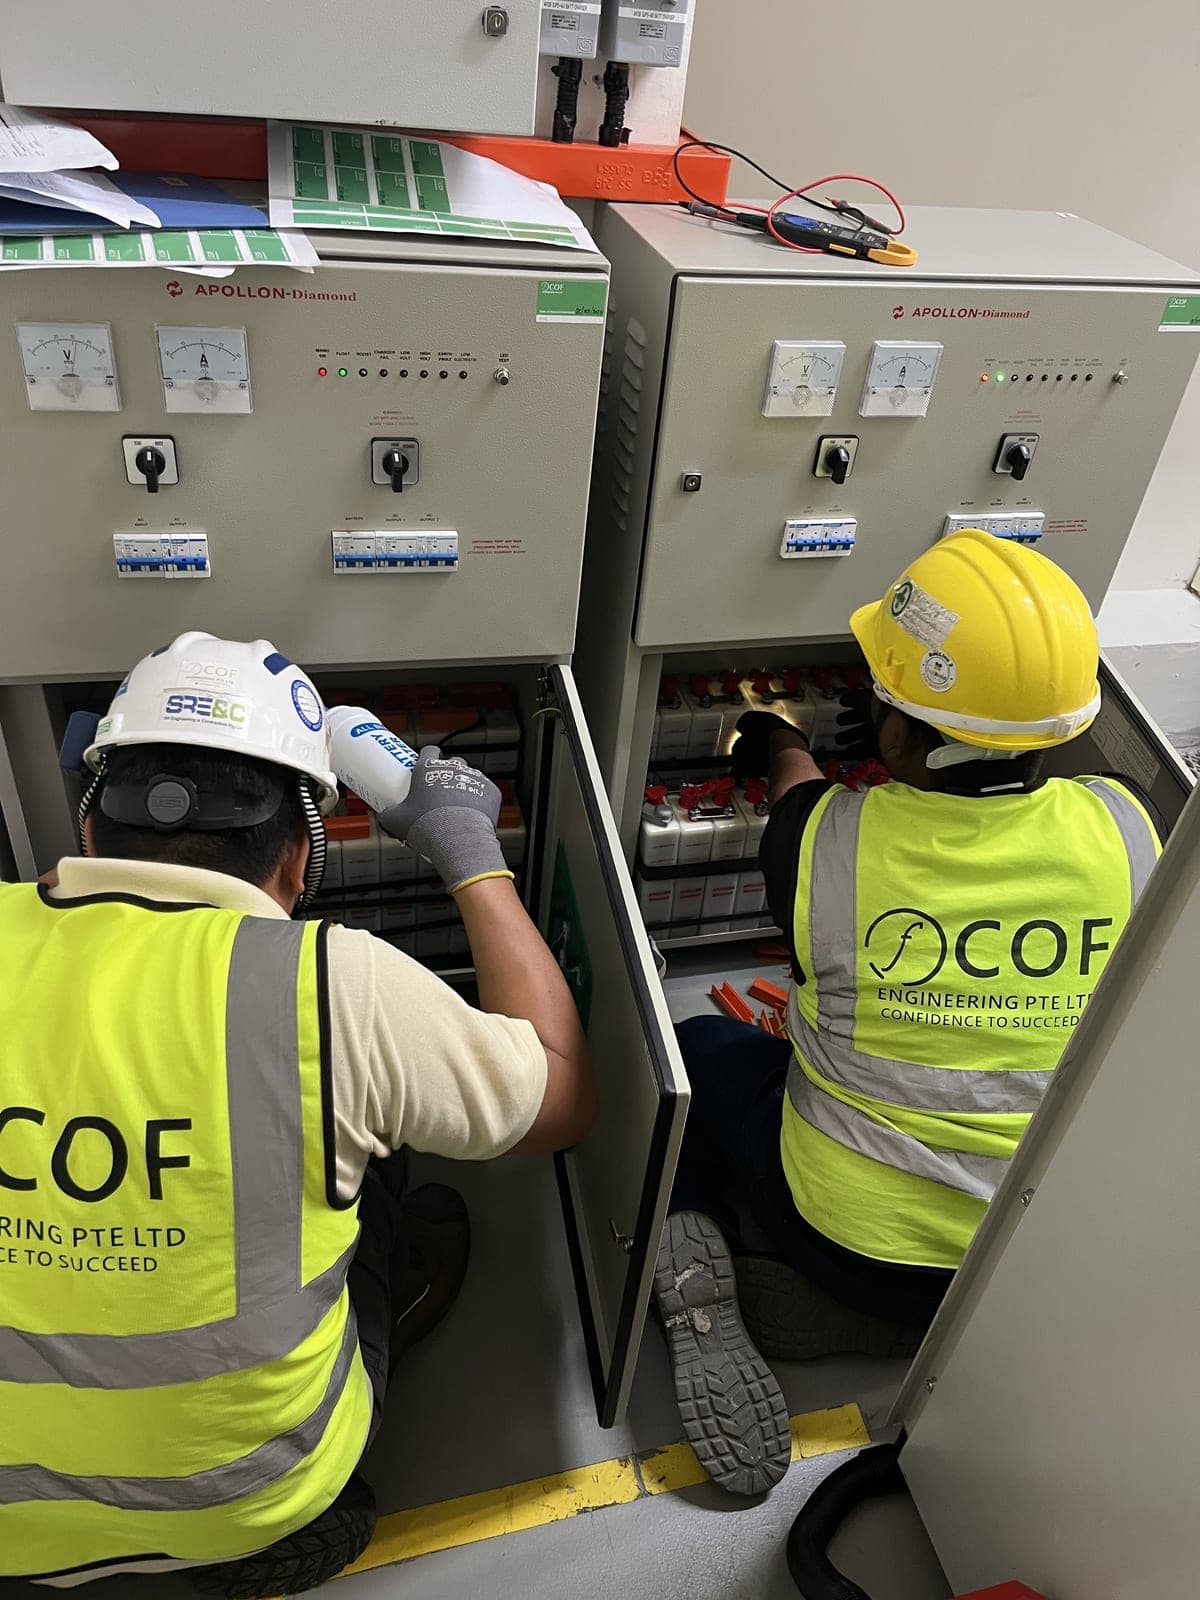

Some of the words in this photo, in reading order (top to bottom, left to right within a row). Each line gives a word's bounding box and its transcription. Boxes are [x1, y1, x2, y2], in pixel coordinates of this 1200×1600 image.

[195, 284, 356, 301] APOLLON-Diamond
[912, 307, 1030, 319] APOLLON-Diamond
[63, 350, 71, 360] V
[200, 353, 208, 364] A
[165, 695, 246, 722] SRE&C
[371, 734, 414, 771] ATTERY
[954, 917, 1113, 978] COF
[877, 987, 1018, 1010] ENGINEERING
[1025, 995, 1060, 1010] PTE
[1067, 993, 1093, 1009] LT
[881, 1007, 982, 1028] CONFIDENCE
[988, 1016, 1008, 1028] TO
[1012, 1015, 1080, 1028] SUCCEED
[0, 1106, 192, 1203] COF
[73, 1227, 123, 1248] PTE
[134, 1227, 186, 1247] LTD
[24, 1249, 53, 1266] TO
[58, 1254, 158, 1272] SUCCEED
